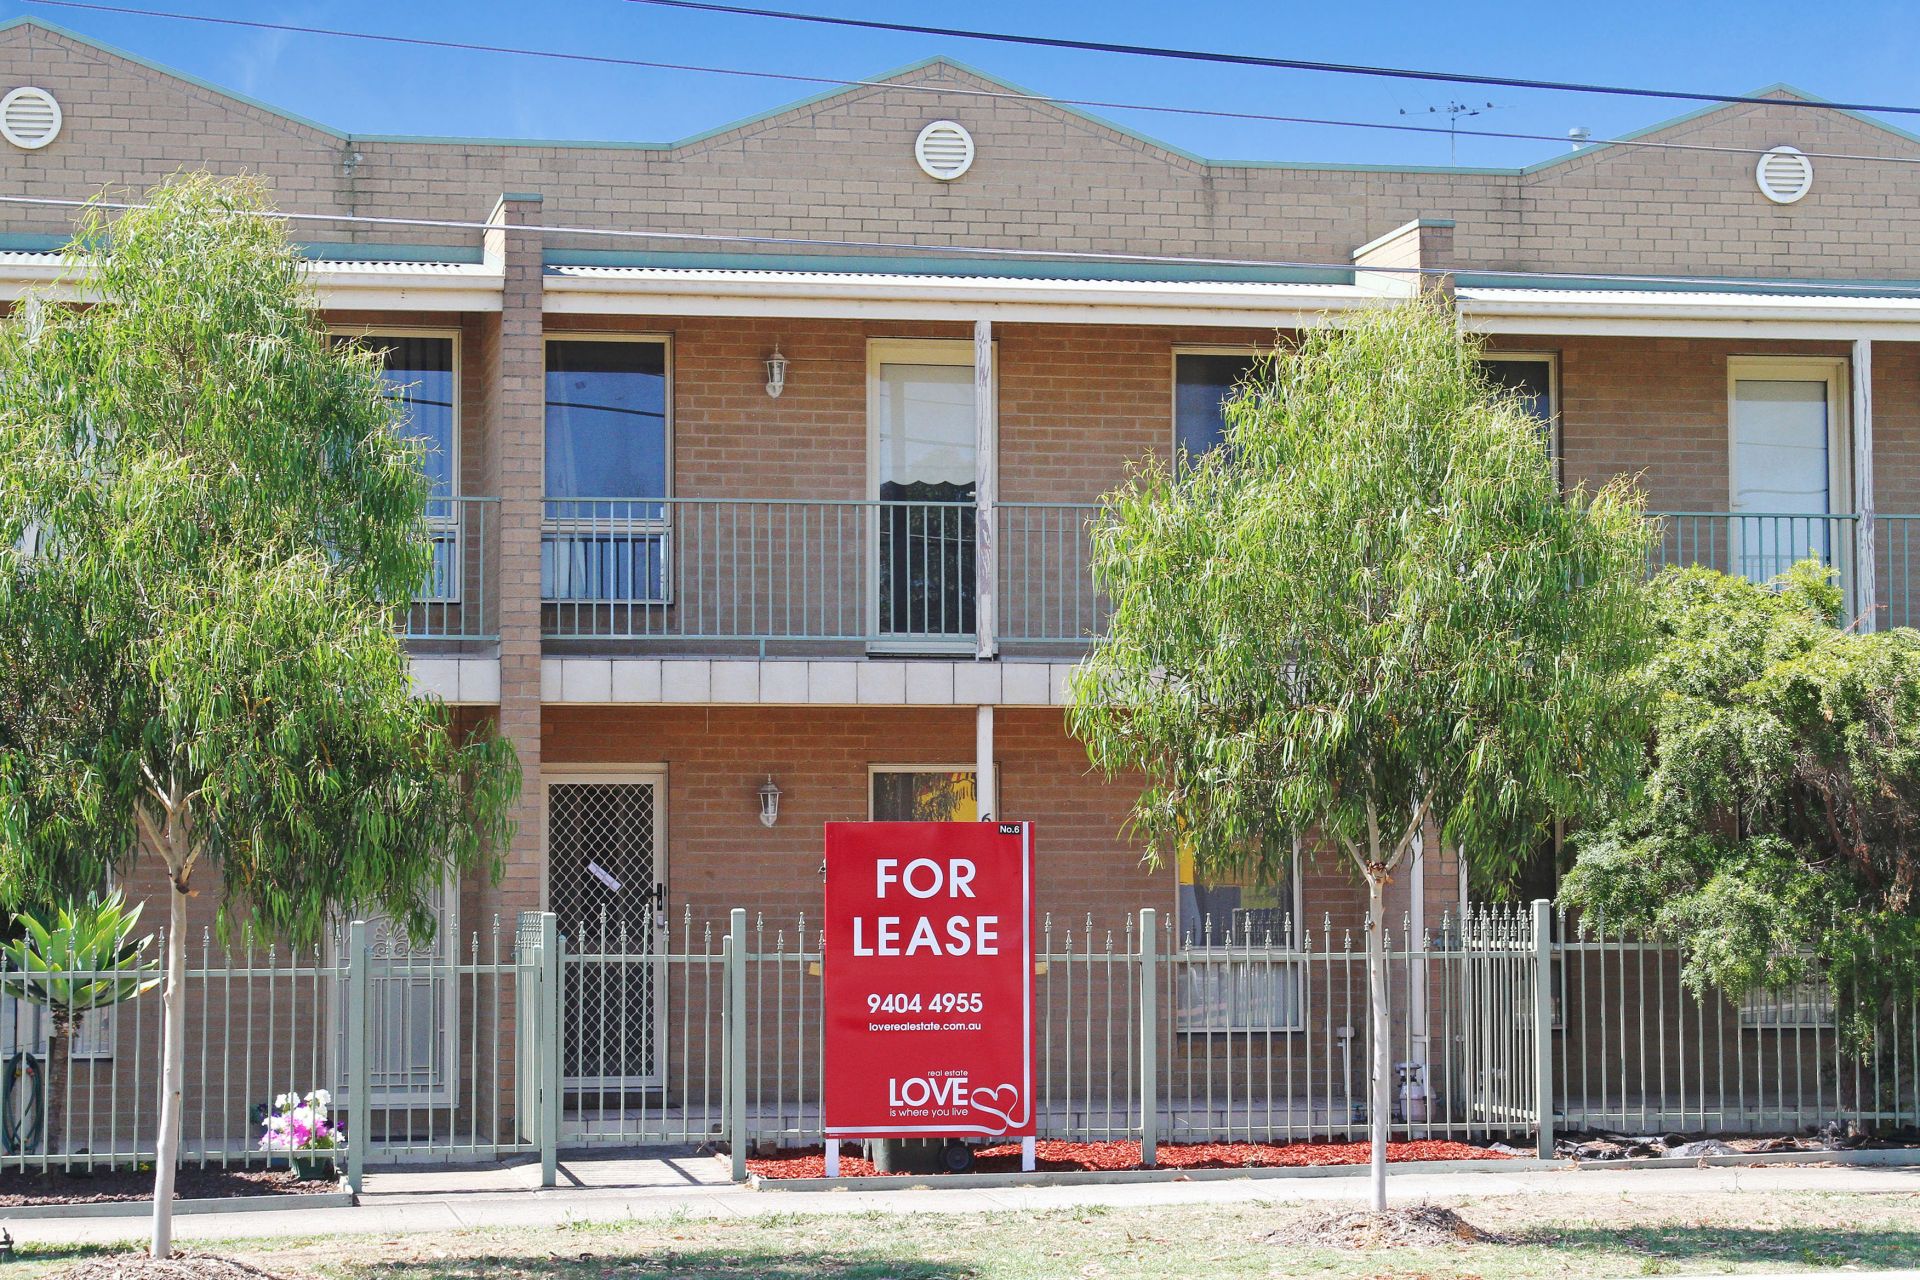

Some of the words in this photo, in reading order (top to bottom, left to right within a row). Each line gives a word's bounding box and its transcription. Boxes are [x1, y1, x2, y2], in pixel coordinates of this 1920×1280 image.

[999, 825, 1020, 834] No.6
[876, 858, 977, 899] FOR
[853, 915, 998, 956] LEASE
[867, 993, 922, 1014] 9404
[928, 993, 983, 1013] 4955
[869, 1022, 982, 1032] loverealestate.com.au
[927, 1069, 943, 1077] real
[944, 1069, 969, 1077] estate
[889, 1077, 968, 1107] LOVE
[889, 1108, 897, 1117] is
[898, 1108, 929, 1117] where
[931, 1109, 950, 1118] you
[951, 1107, 969, 1116] live
